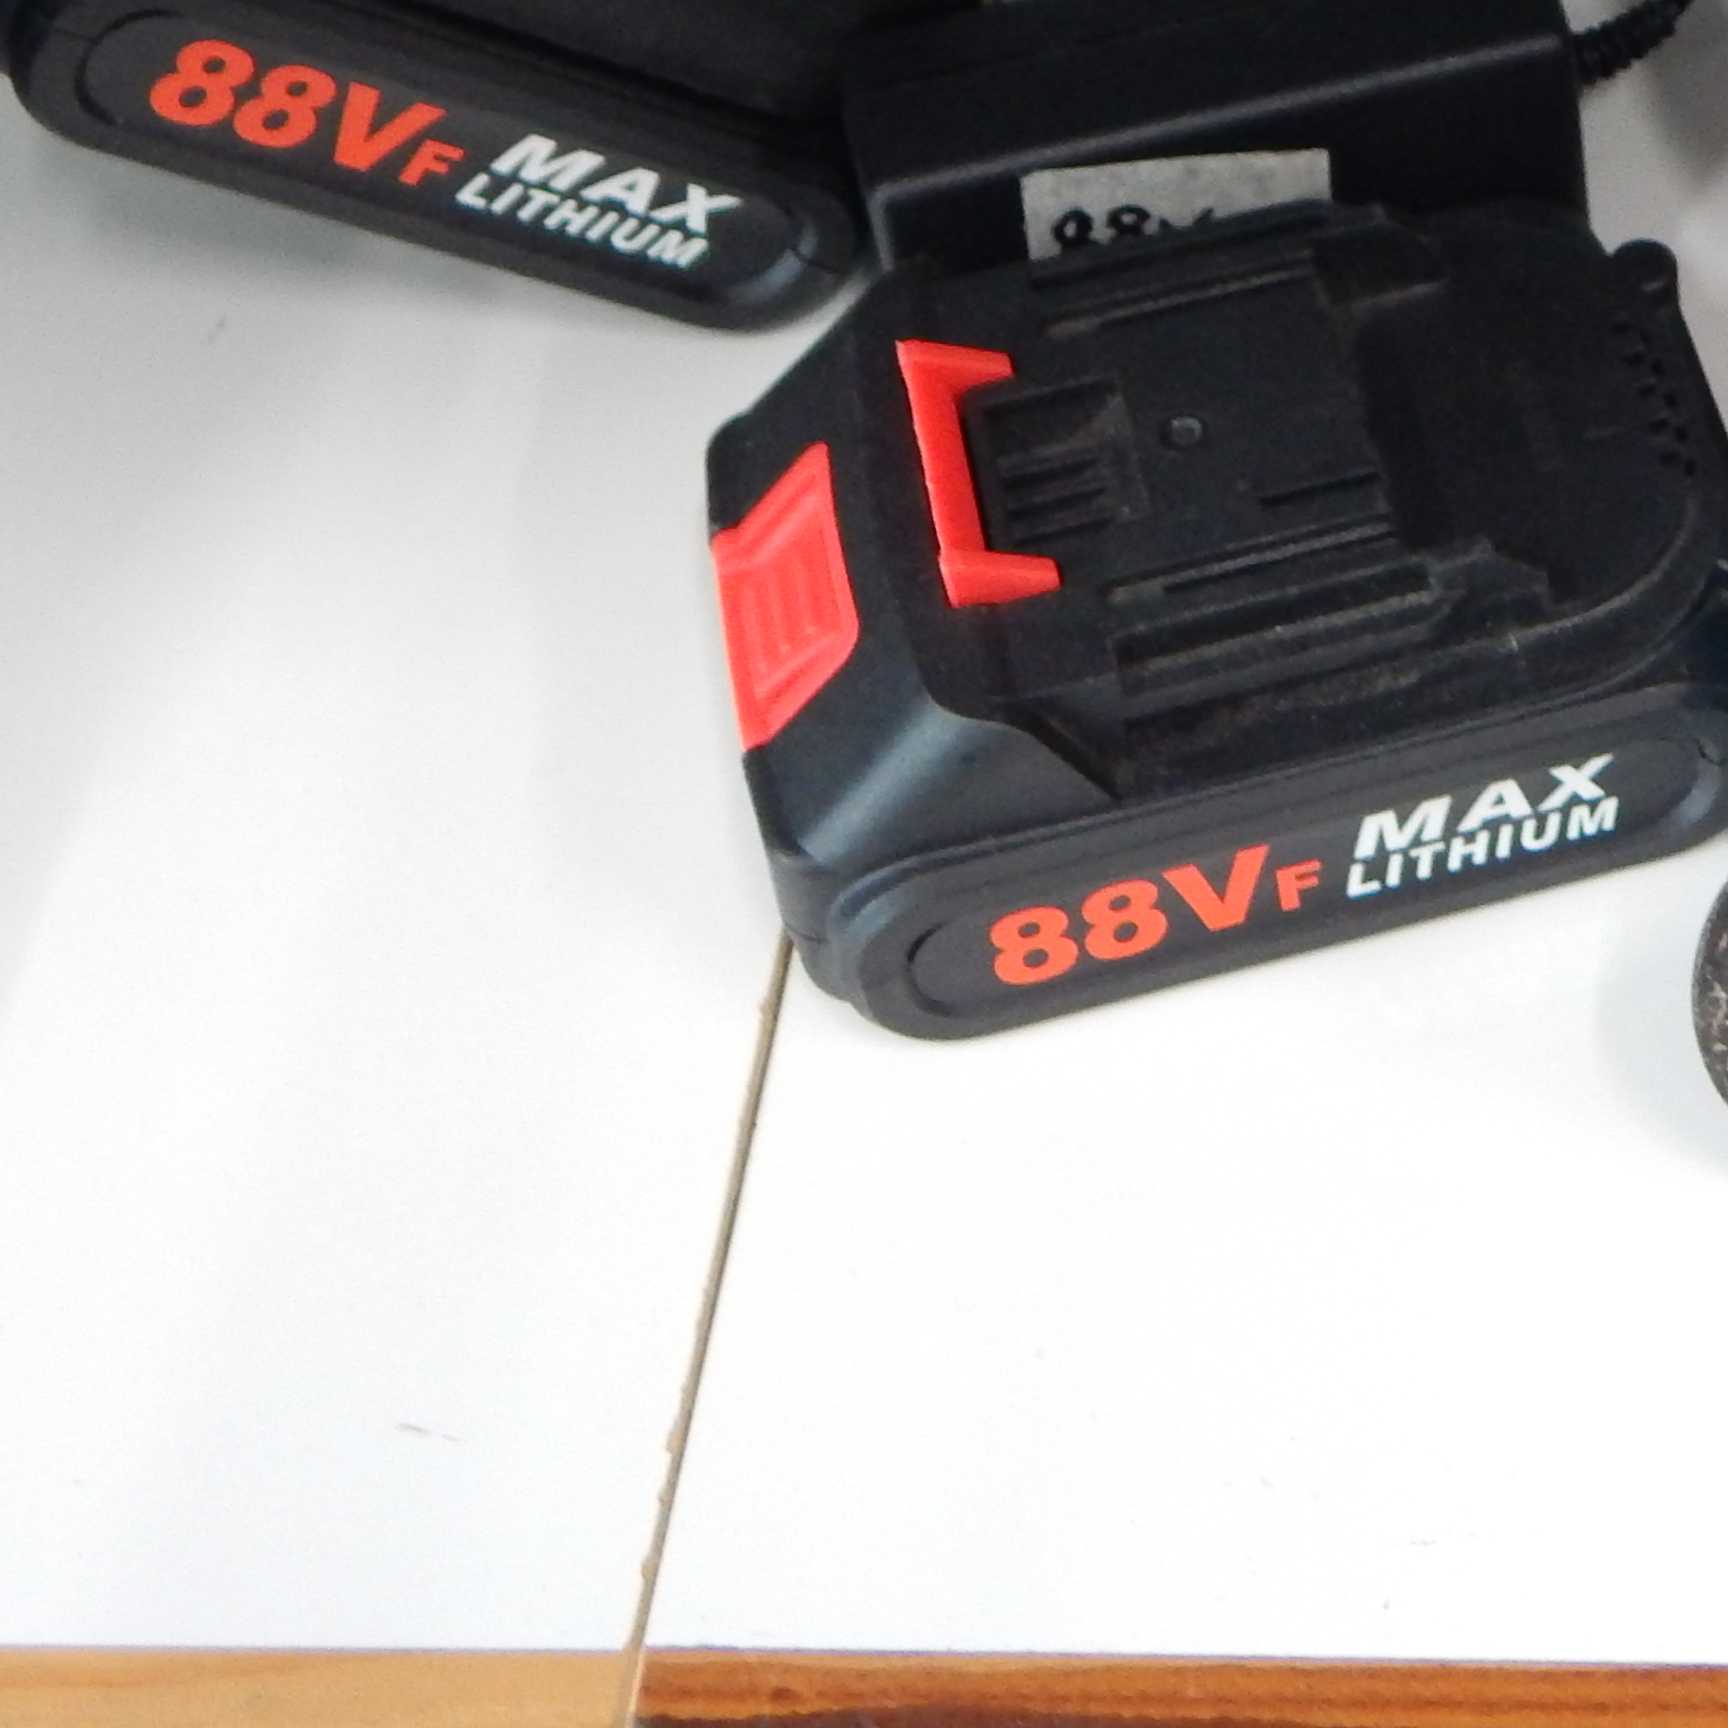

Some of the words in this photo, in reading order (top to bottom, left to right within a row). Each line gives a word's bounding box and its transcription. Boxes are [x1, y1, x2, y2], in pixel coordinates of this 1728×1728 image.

[453, 172, 710, 270] LITHIUM
[490, 133, 742, 233] MAX
[1344, 796, 1620, 900] LITHIUM
[1353, 753, 1616, 860] MAX
